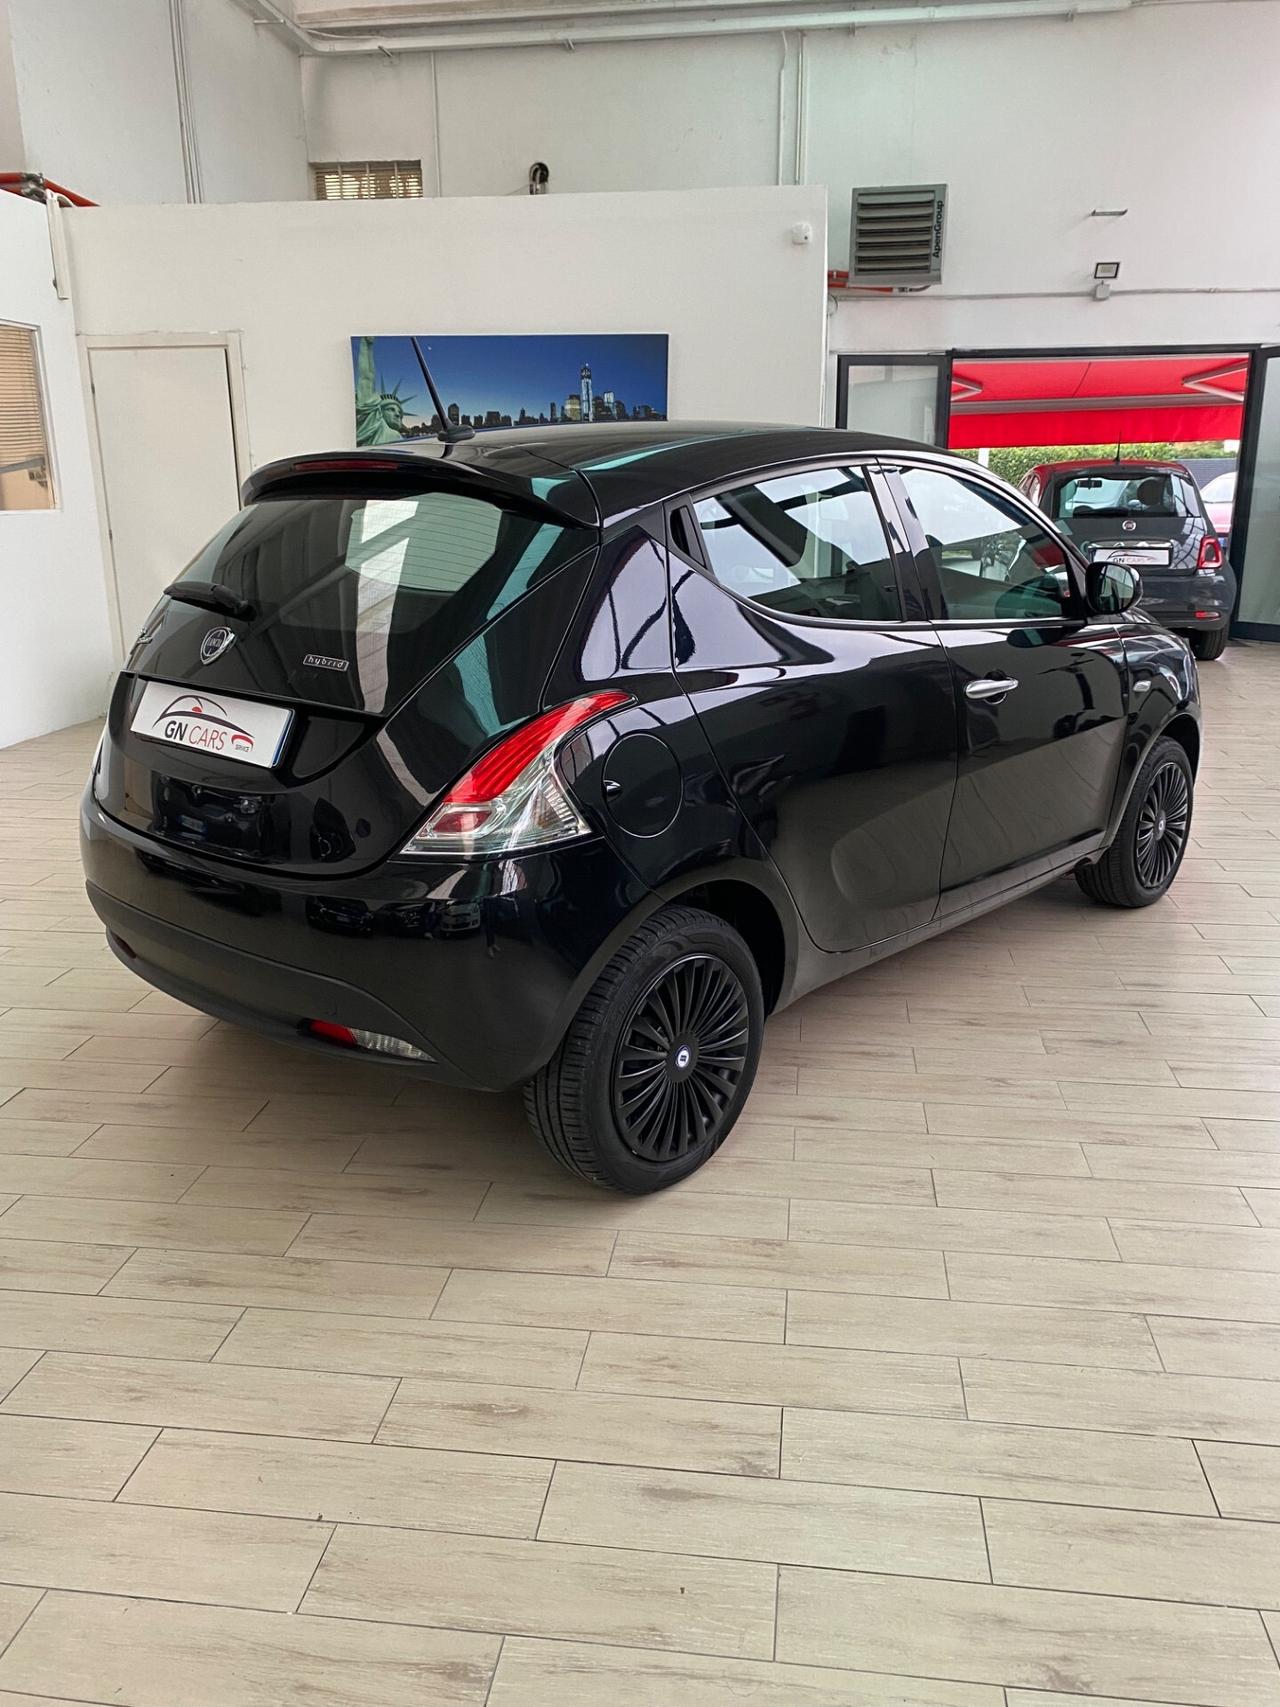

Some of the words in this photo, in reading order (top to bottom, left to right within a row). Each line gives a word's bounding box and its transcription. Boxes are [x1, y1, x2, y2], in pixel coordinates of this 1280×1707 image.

[932, 200, 944, 258] ApenGroup
[308, 656, 344, 668] hybrid
[164, 720, 188, 741] GN
[188, 725, 228, 751] CARS
